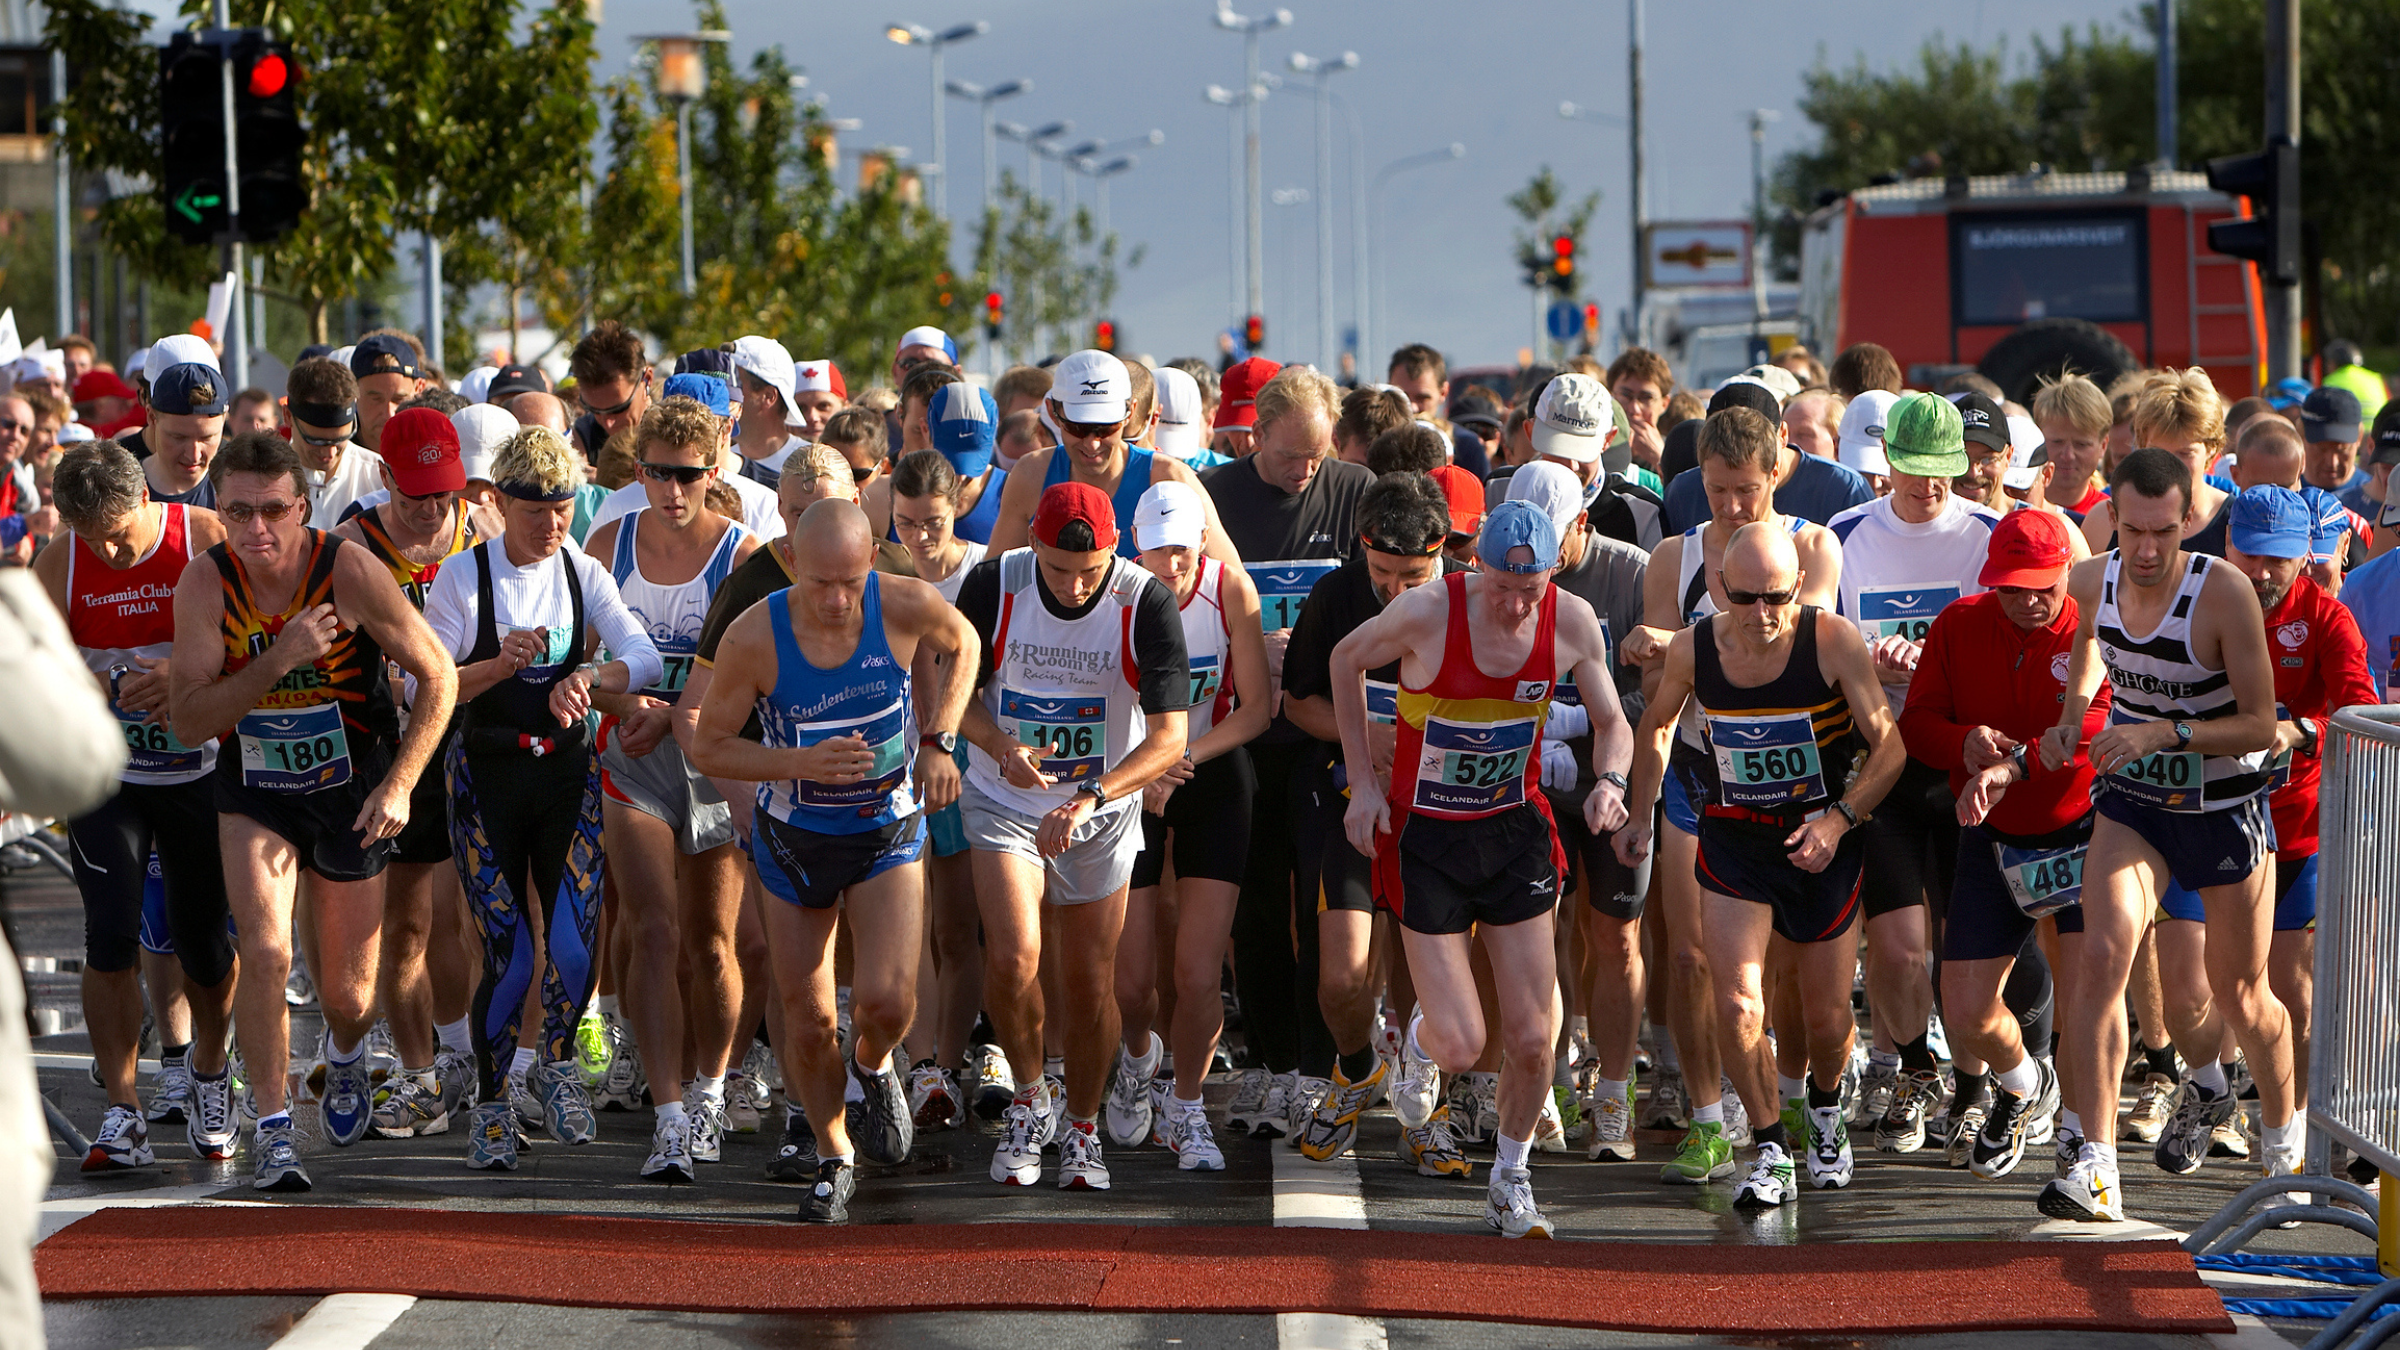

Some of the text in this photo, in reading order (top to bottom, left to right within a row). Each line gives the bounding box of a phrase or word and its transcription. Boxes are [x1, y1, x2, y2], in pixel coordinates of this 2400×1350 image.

[82, 586, 139, 607] Terramia
[118, 601, 159, 617] ITALIA
[1021, 643, 1100, 671] Running
[1023, 667, 1065, 685] Racing
[787, 679, 888, 722] Studenterna
[1034, 726, 1093, 759] 106
[274, 737, 334, 771] 180
[1744, 747, 1807, 782] 560
[1455, 751, 1518, 787] 522
[258, 780, 316, 789] ICELANDAIR
[813, 788, 873, 798] ICELANDAIR
[2109, 781, 2163, 804] ICELANDAIR
[1430, 791, 1490, 805] ICELANDAIR
[1732, 792, 1788, 801] ICELANDAIR
